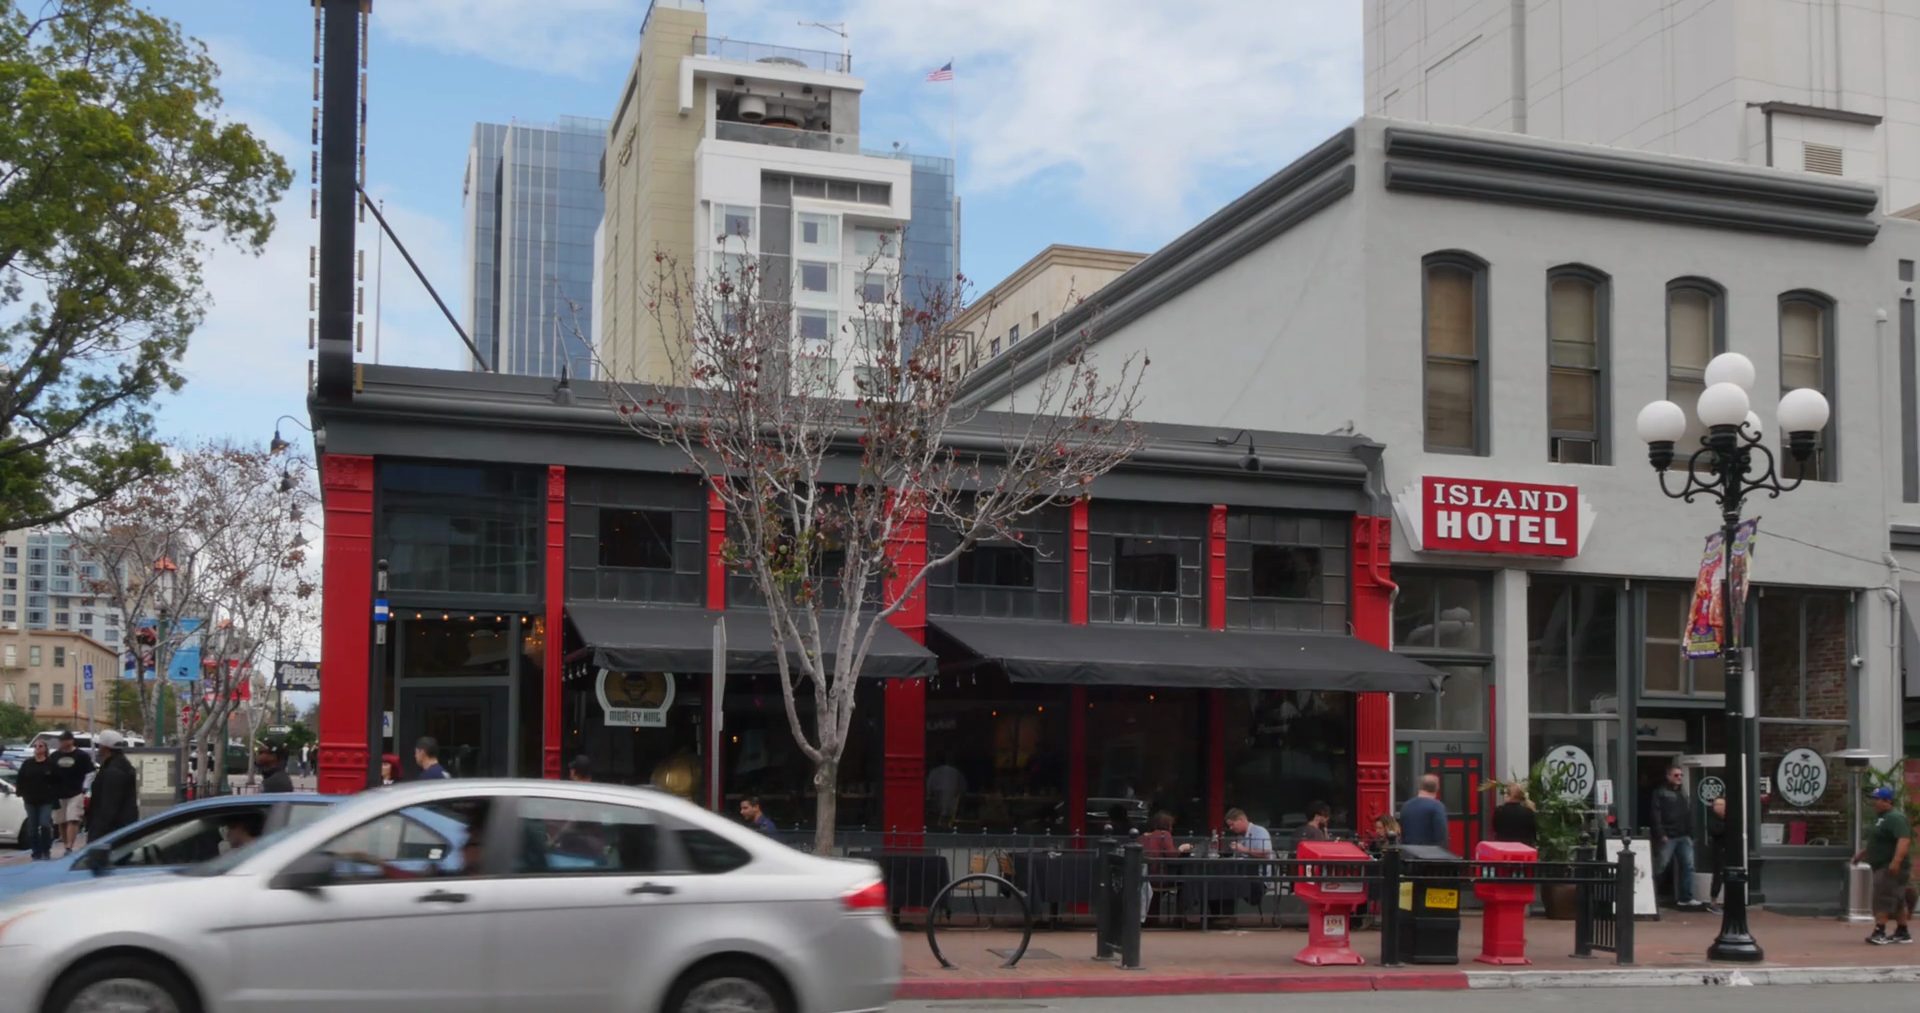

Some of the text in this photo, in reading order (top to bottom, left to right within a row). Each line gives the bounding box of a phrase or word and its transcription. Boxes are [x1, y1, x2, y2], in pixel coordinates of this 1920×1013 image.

[1434, 483, 1568, 512] ISLAND
[1436, 510, 1567, 545] HOTEL
[283, 674, 319, 685] PIZZA
[609, 710, 661, 723] MONKEY KING
[1444, 743, 1462, 754] 461
[1784, 761, 1820, 780] FOOD
[1557, 777, 1587, 795] HOP
[1786, 776, 1820, 796] SHOP
[1427, 893, 1456, 905] Reader
